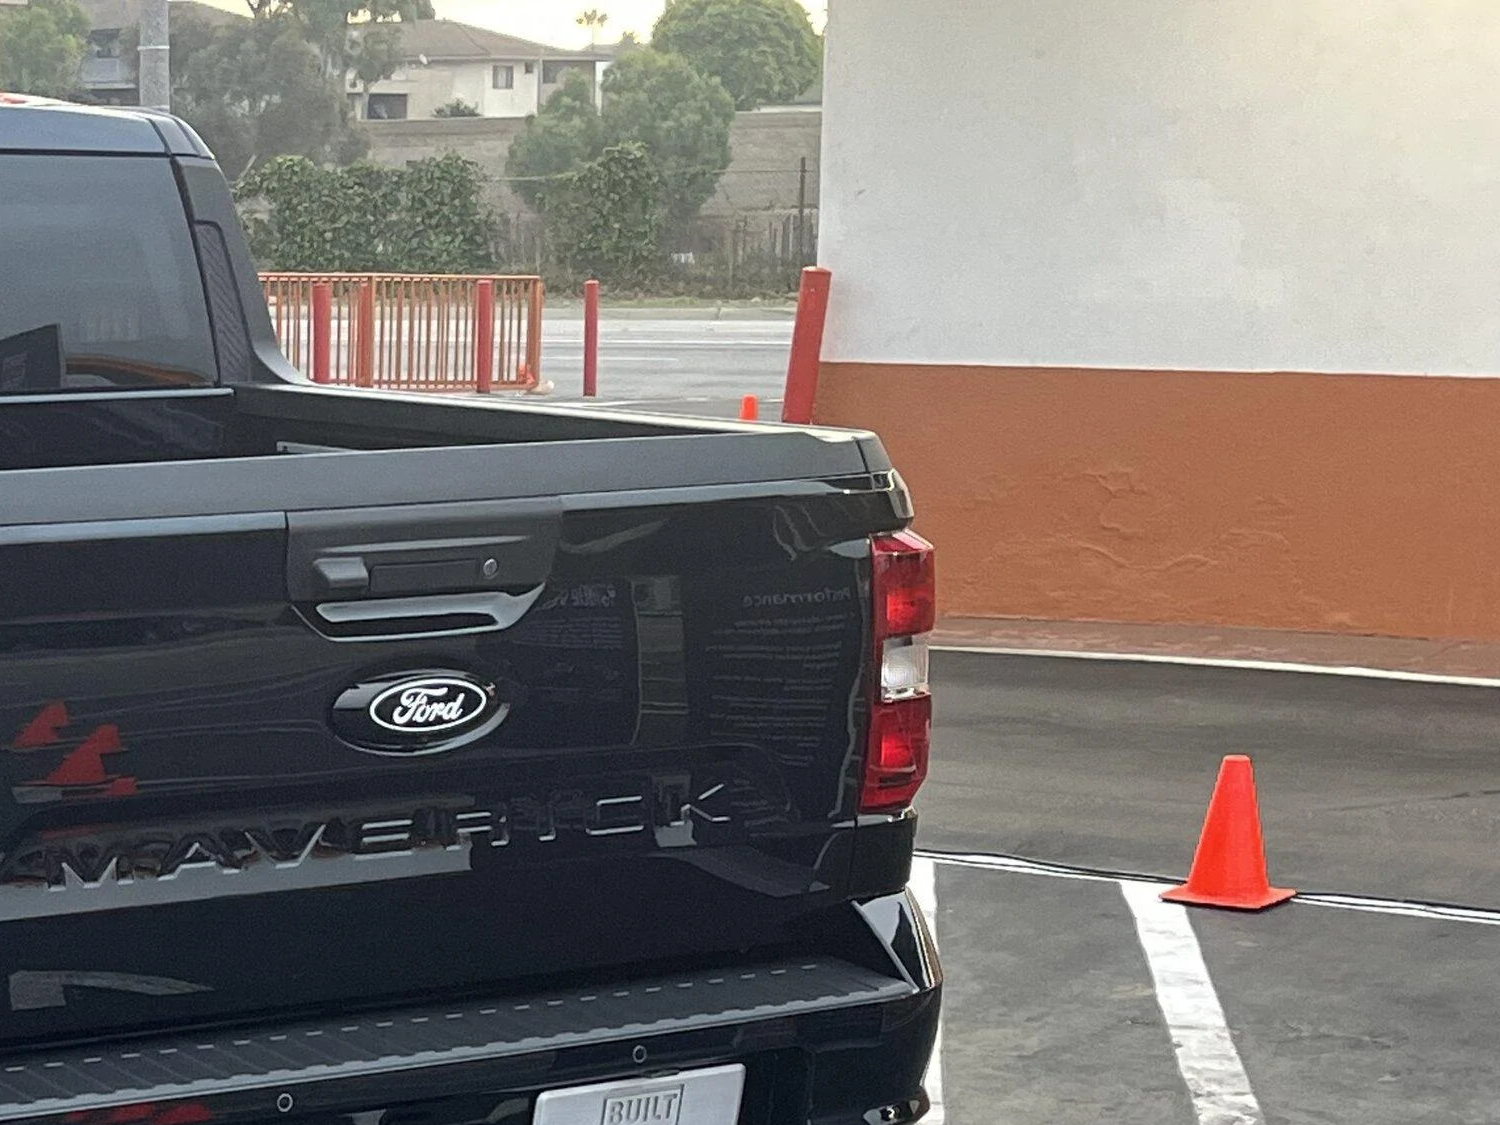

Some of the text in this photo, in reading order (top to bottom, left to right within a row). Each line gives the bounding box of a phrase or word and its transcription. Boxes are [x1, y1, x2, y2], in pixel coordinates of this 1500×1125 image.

[392, 687, 466, 725] Ford
[46, 784, 730, 891] MAVERICK
[609, 1094, 677, 1125] BUILT
